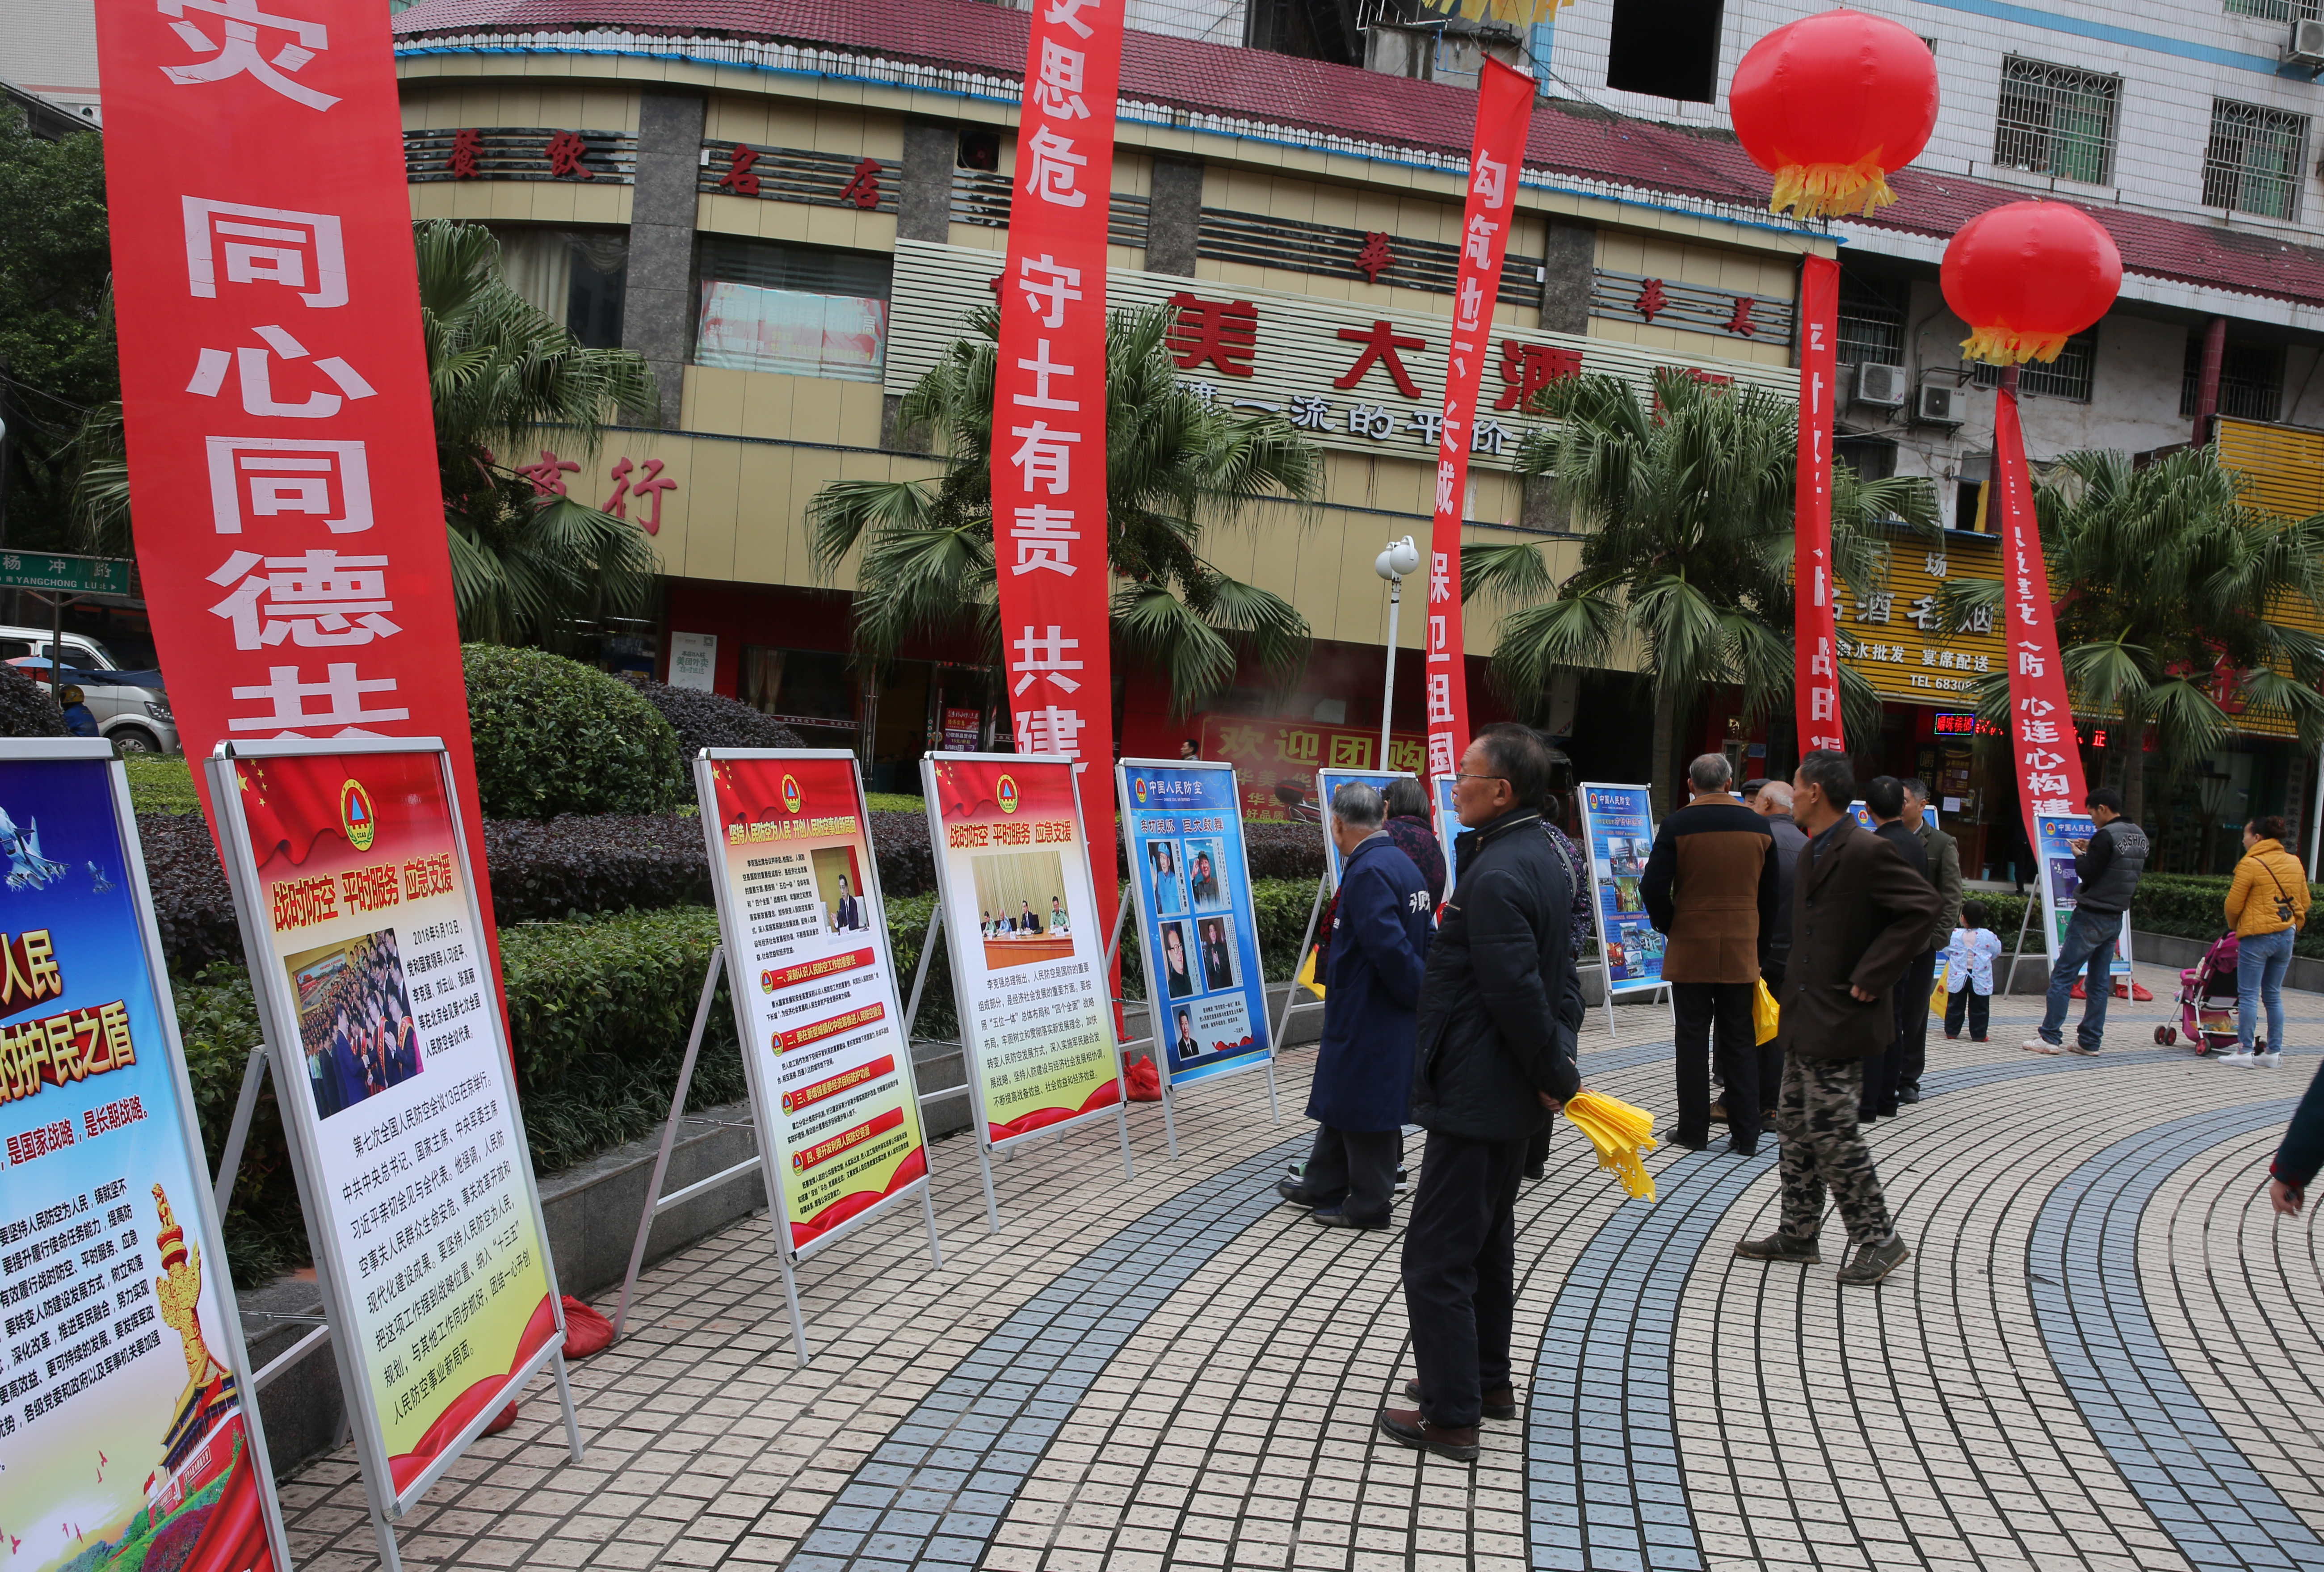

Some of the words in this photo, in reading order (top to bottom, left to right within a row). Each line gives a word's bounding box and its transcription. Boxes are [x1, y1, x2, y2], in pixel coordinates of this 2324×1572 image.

[1010, 253, 1082, 577] 守土有责
[1925, 552, 1947, 577] 场
[16, 576, 77, 588] YANGCHONG
[677, 656, 709, 668] 美团外卖
[1922, 649, 1988, 673] 宴席配送
[1910, 675, 1931, 688] TEL
[1217, 725, 1426, 777] 欢迎团购
[1149, 780, 1202, 795] 中国人民防空
[1599, 795, 1630, 806] 中国人民防空
[727, 820, 793, 845] 坚持人民防空为人民
[791, 815, 858, 840] 开创人民防空事业新局面
[950, 823, 988, 849] 战时防空
[993, 821, 1030, 847] 平时服务
[1035, 820, 1072, 844] 应急支援
[1140, 818, 1175, 834] 亲切关怀
[1182, 817, 1224, 833] 巨大鼓舞
[273, 874, 340, 932] 战时防空
[342, 862, 399, 916] 平时服务
[403, 852, 454, 903] 应急支援
[2, 929, 61, 1001] 人民
[775, 953, 857, 985] 一、深刻认识人民防空工作的重要性
[417, 992, 481, 1033] 等在北京会见第七次全国
[795, 1065, 871, 1106] 三、要增强重要经济目标防护功能
[806, 1123, 871, 1165] 四、要开发利用人民防空资源
